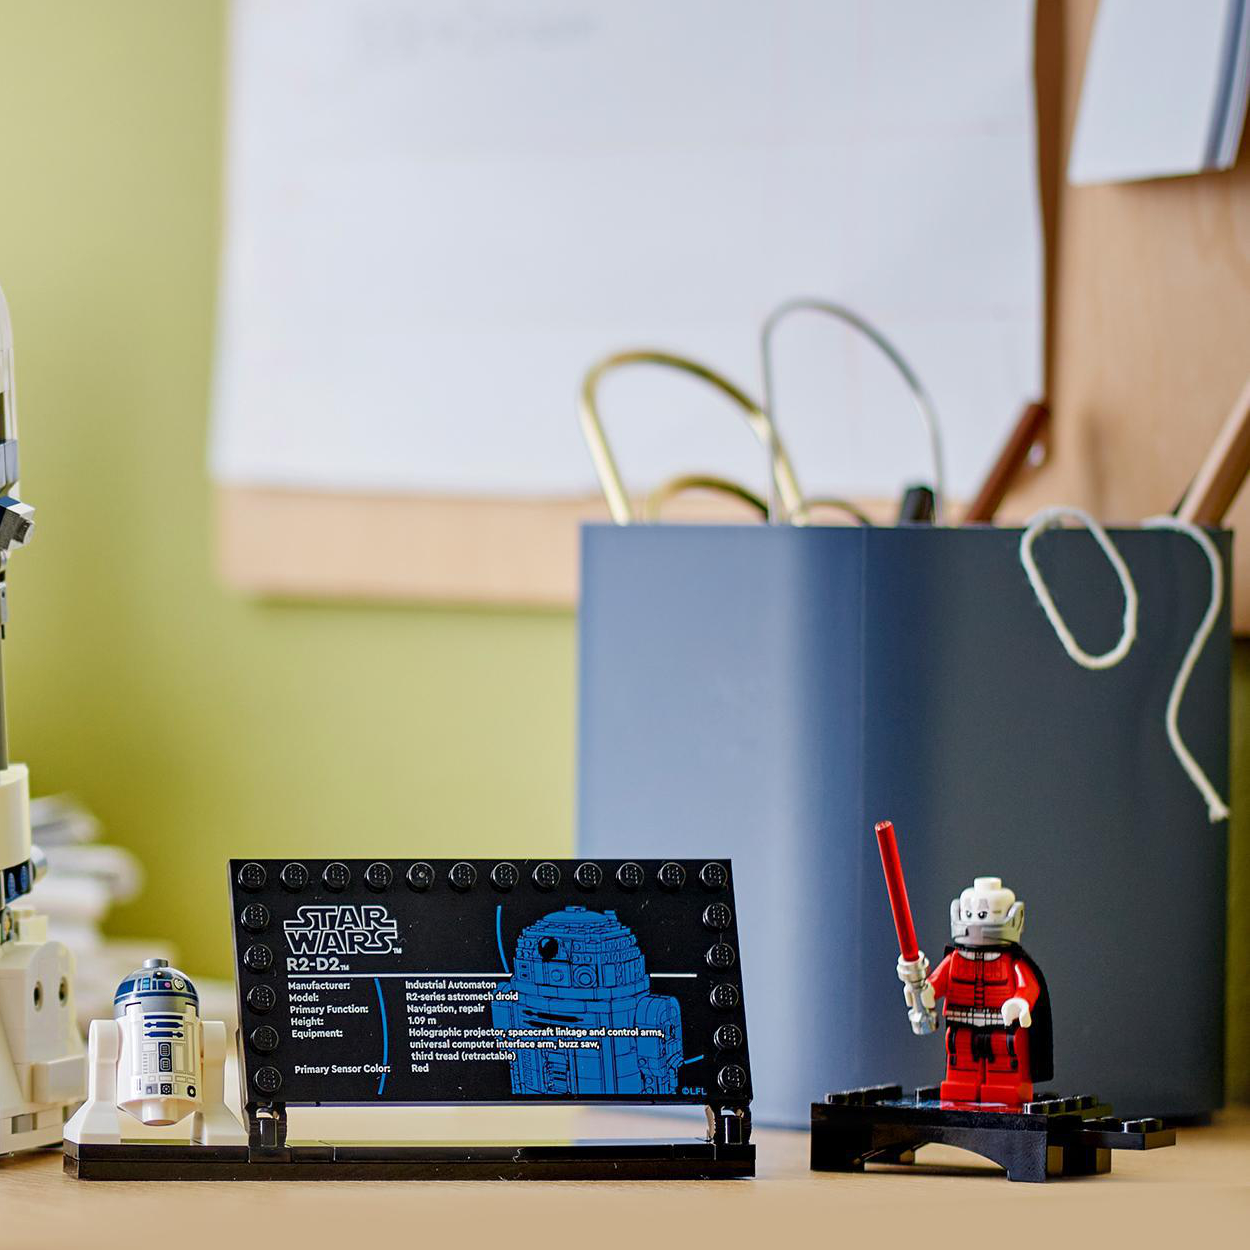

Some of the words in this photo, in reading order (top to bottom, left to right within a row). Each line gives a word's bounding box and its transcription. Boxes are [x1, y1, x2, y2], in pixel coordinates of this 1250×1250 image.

[283, 905, 397, 930] STAR
[288, 980, 350, 990] Manufacturer:
[405, 980, 446, 989] Industrial
[447, 980, 497, 989] Automaton
[289, 992, 319, 1002] Model:
[406, 992, 446, 1001] R2-series
[447, 992, 494, 1001] astromech
[495, 991, 519, 1001] droid
[290, 1005, 325, 1015] Primary
[326, 1004, 369, 1013] Function:
[407, 1003, 457, 1015] Navigation,
[458, 1003, 485, 1015] repair
[290, 1016, 324, 1027] Height:
[408, 1016, 426, 1025] 1.09
[291, 1029, 343, 1040] Equipment:
[408, 1027, 462, 1037] Holographic
[463, 1027, 506, 1038] projector,
[508, 1027, 554, 1037] spacecraft
[555, 1027, 587, 1038] linkage
[589, 1027, 605, 1036] and
[607, 1027, 639, 1036] control
[640, 1029, 665, 1038] arms,
[409, 1039, 450, 1048] universal
[451, 1040, 495, 1049] computer
[496, 1039, 535, 1048] interface
[537, 1040, 557, 1049] arm,
[558, 1039, 579, 1048] buzz
[580, 1040, 600, 1049] saw,
[411, 1051, 433, 1060] third
[435, 1051, 459, 1060] tread
[461, 1051, 516, 1061] (retractable)
[294, 1064, 329, 1075] Primary
[331, 1065, 362, 1073] Sensor
[363, 1063, 391, 1073] Color:
[411, 1063, 429, 1072] Red
